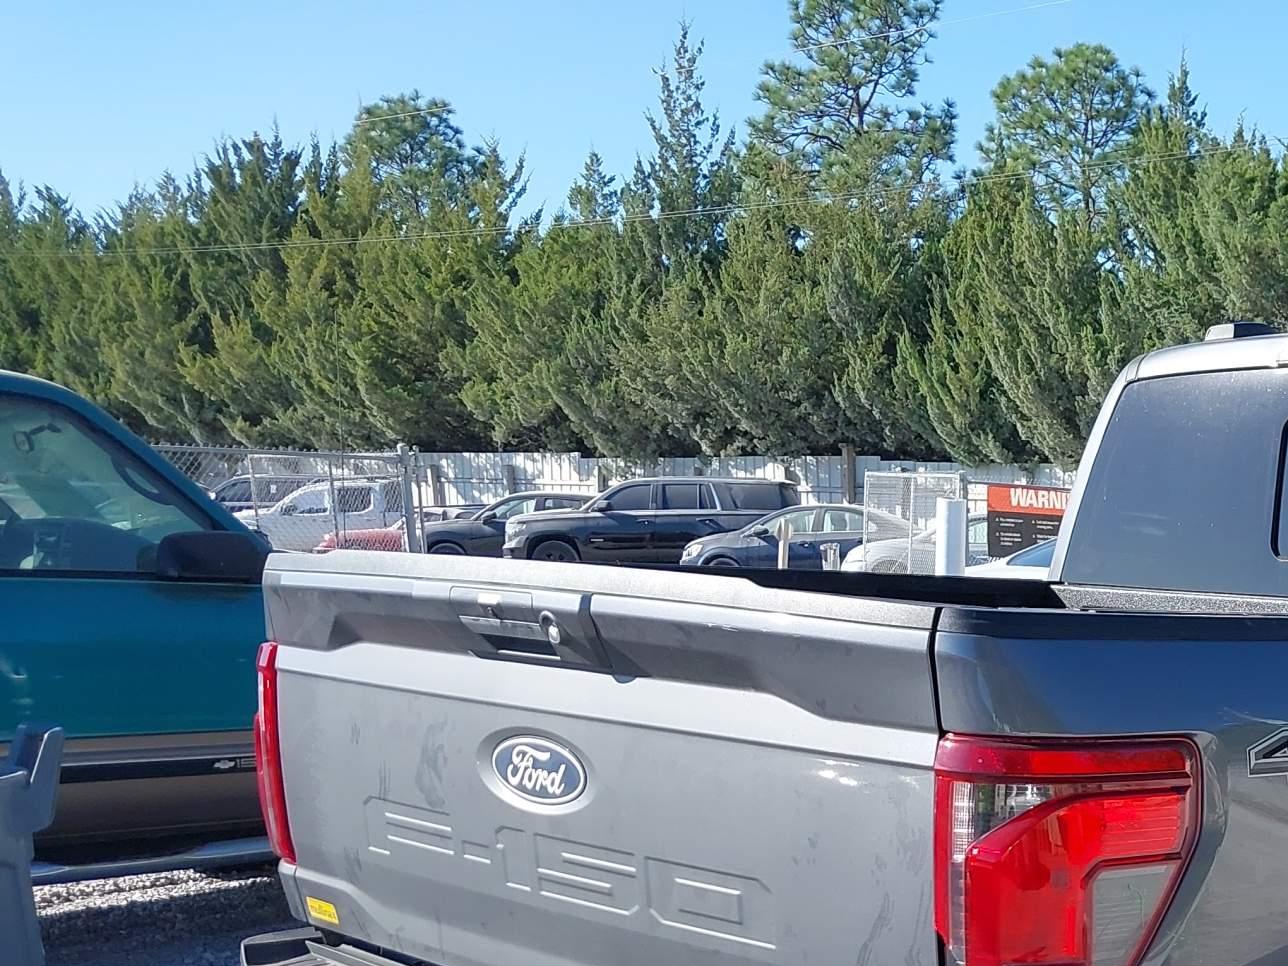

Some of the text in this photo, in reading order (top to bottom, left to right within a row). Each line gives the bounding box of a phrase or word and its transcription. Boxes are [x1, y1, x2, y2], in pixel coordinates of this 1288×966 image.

[1010, 488, 1071, 510] WARNI
[507, 744, 566, 796] Ford
[363, 796, 777, 951] F-150
